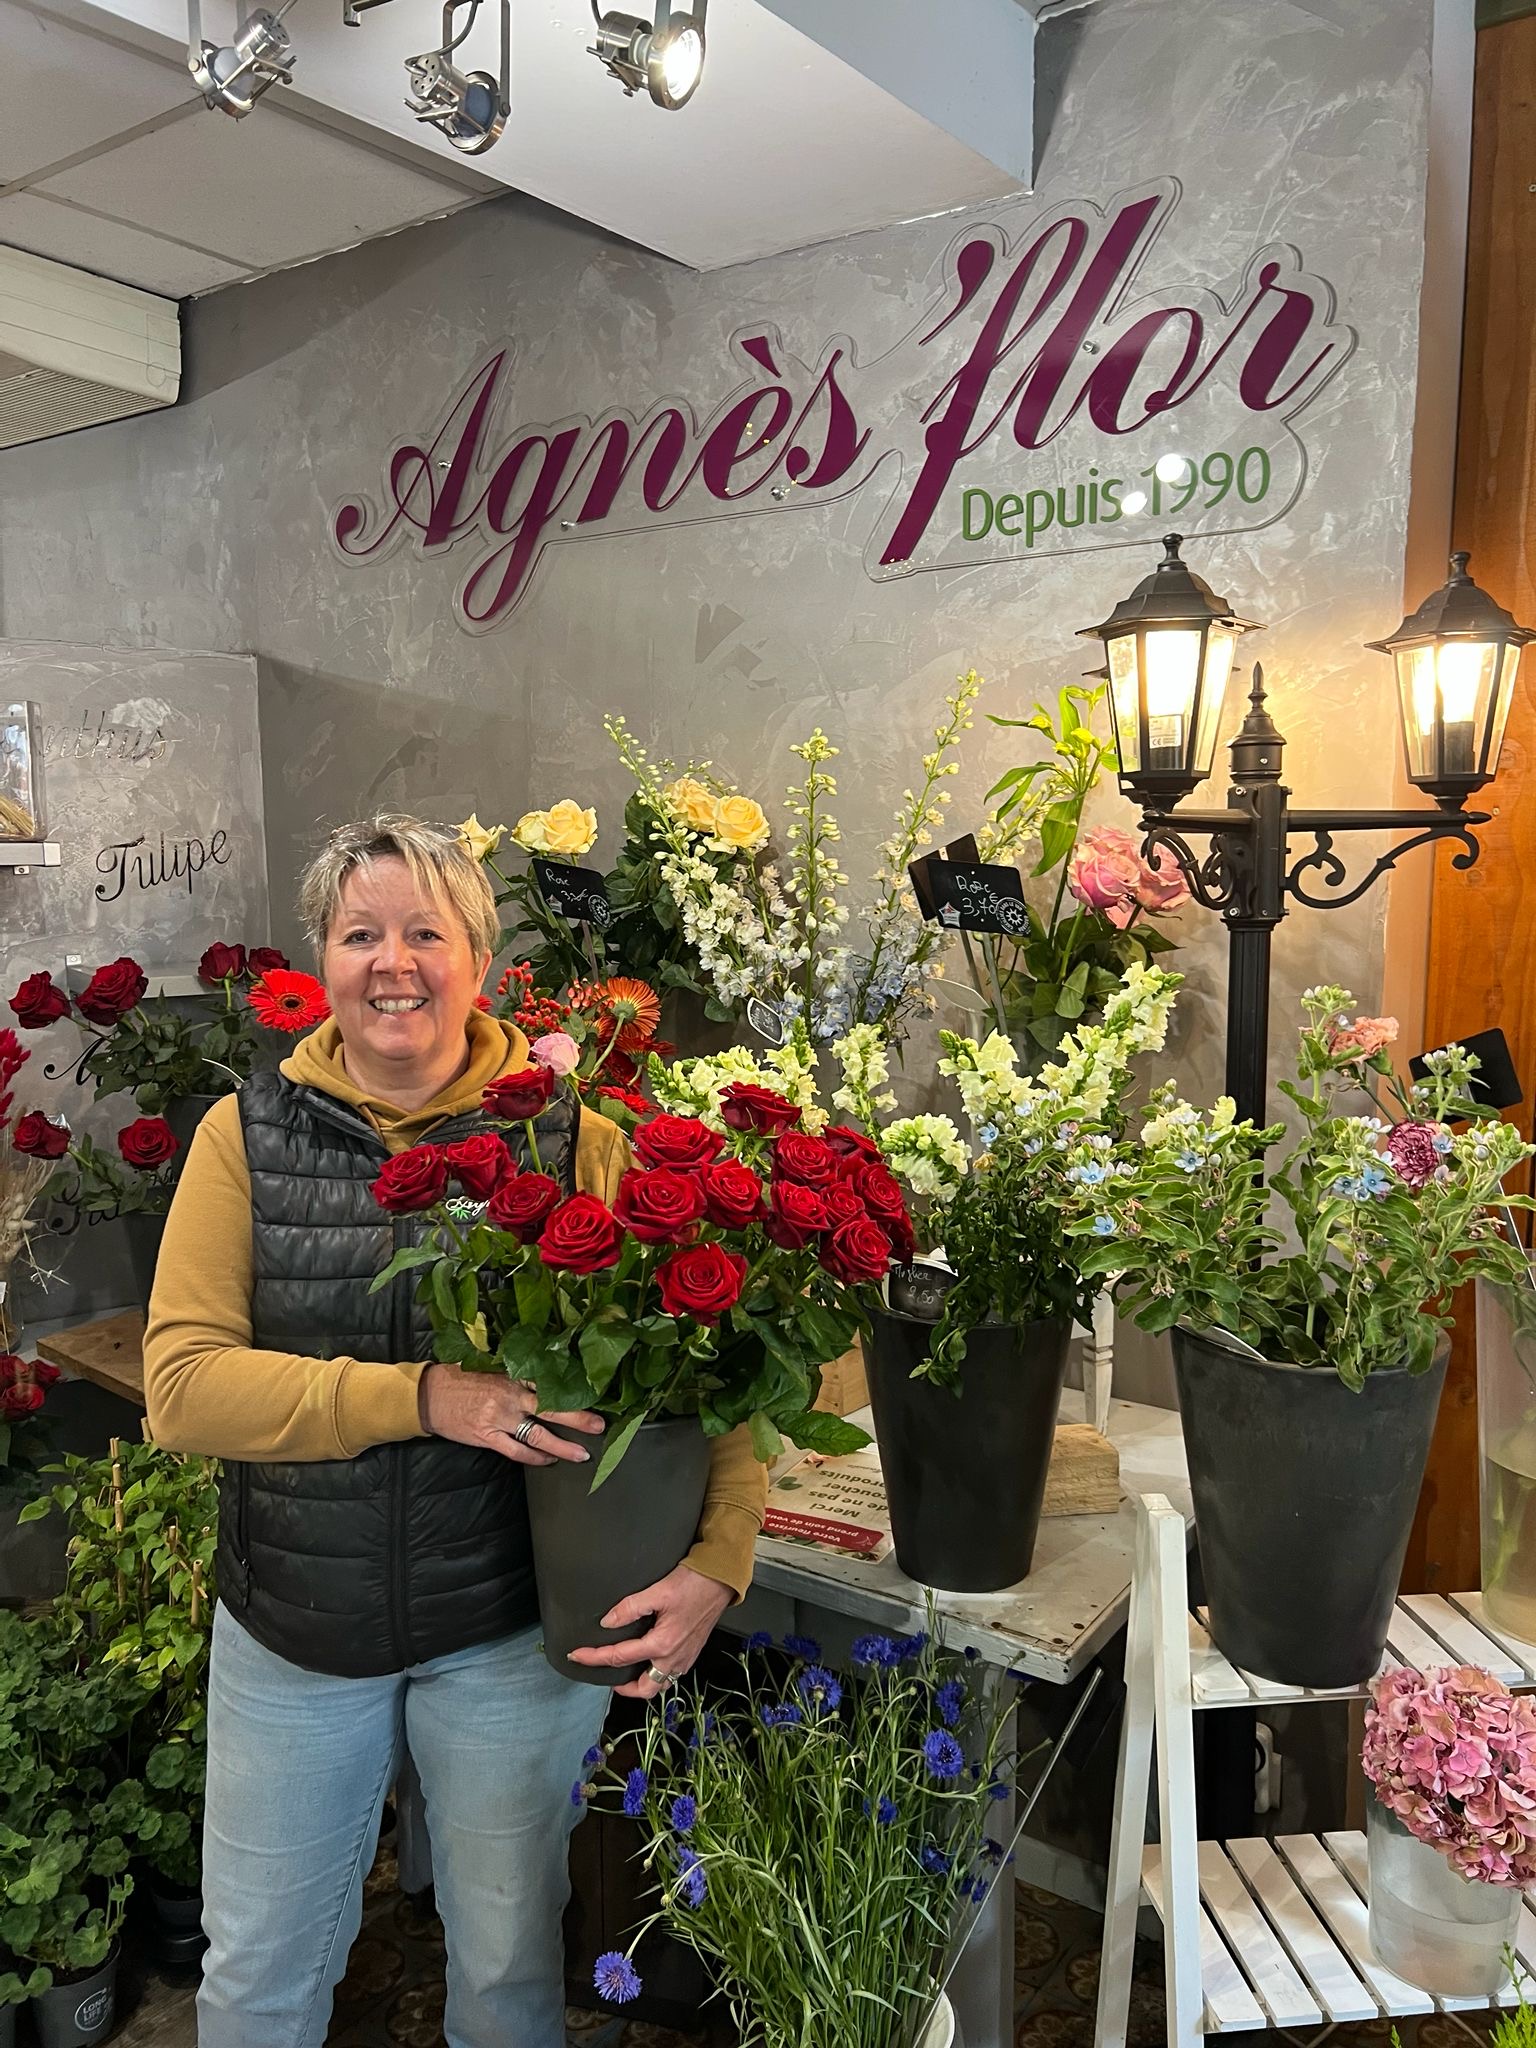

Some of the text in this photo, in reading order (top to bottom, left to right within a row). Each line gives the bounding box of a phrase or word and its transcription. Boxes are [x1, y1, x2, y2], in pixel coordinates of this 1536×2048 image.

[962, 446, 1272, 548] Depuis 1990
[94, 829, 233, 903] Tulipe
[808, 1490, 888, 1512] de ne pas
[809, 1503, 861, 1518] Merci
[768, 1522, 841, 1543] Votre fleuriste
[805, 1520, 826, 1529] soin
[826, 1525, 859, 1537] prend
